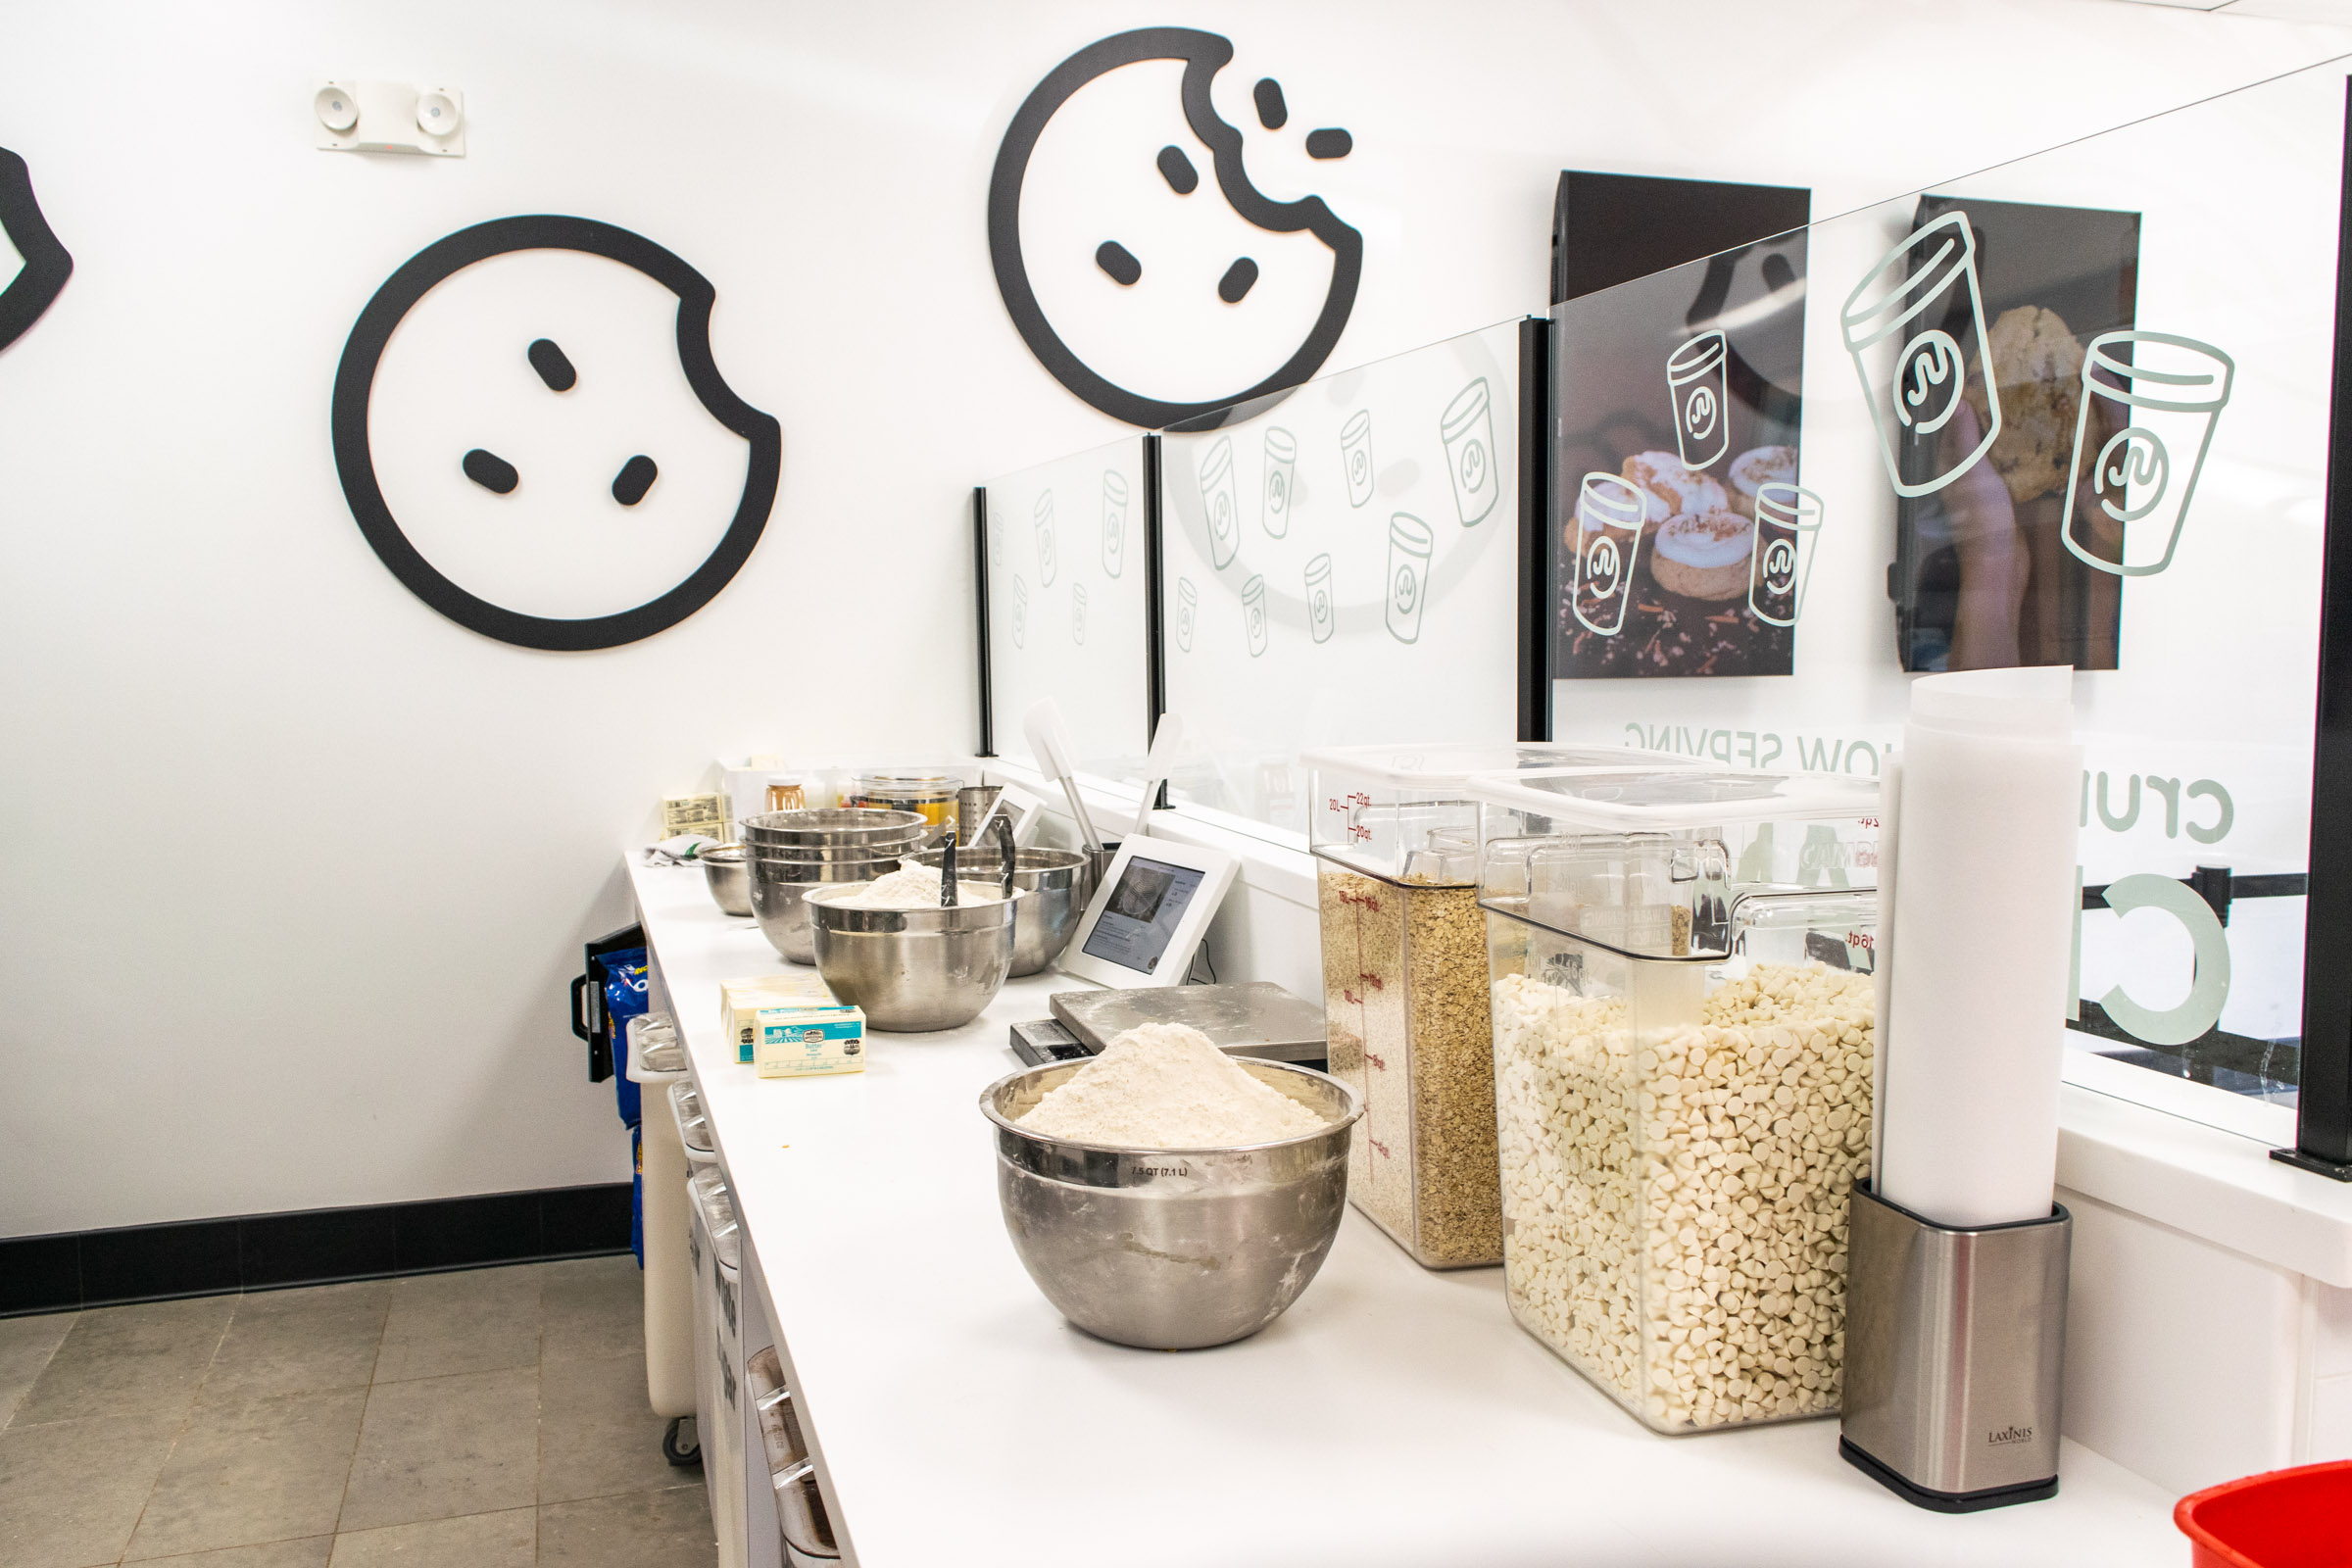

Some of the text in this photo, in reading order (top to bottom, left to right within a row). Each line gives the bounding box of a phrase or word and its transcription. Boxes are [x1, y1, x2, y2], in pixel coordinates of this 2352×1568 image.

[1329, 798, 1341, 812] 20L
[1131, 1166, 1188, 1177] 7.5 QT (7.1 L)
[1988, 1427, 2033, 1444] LAXINIS
